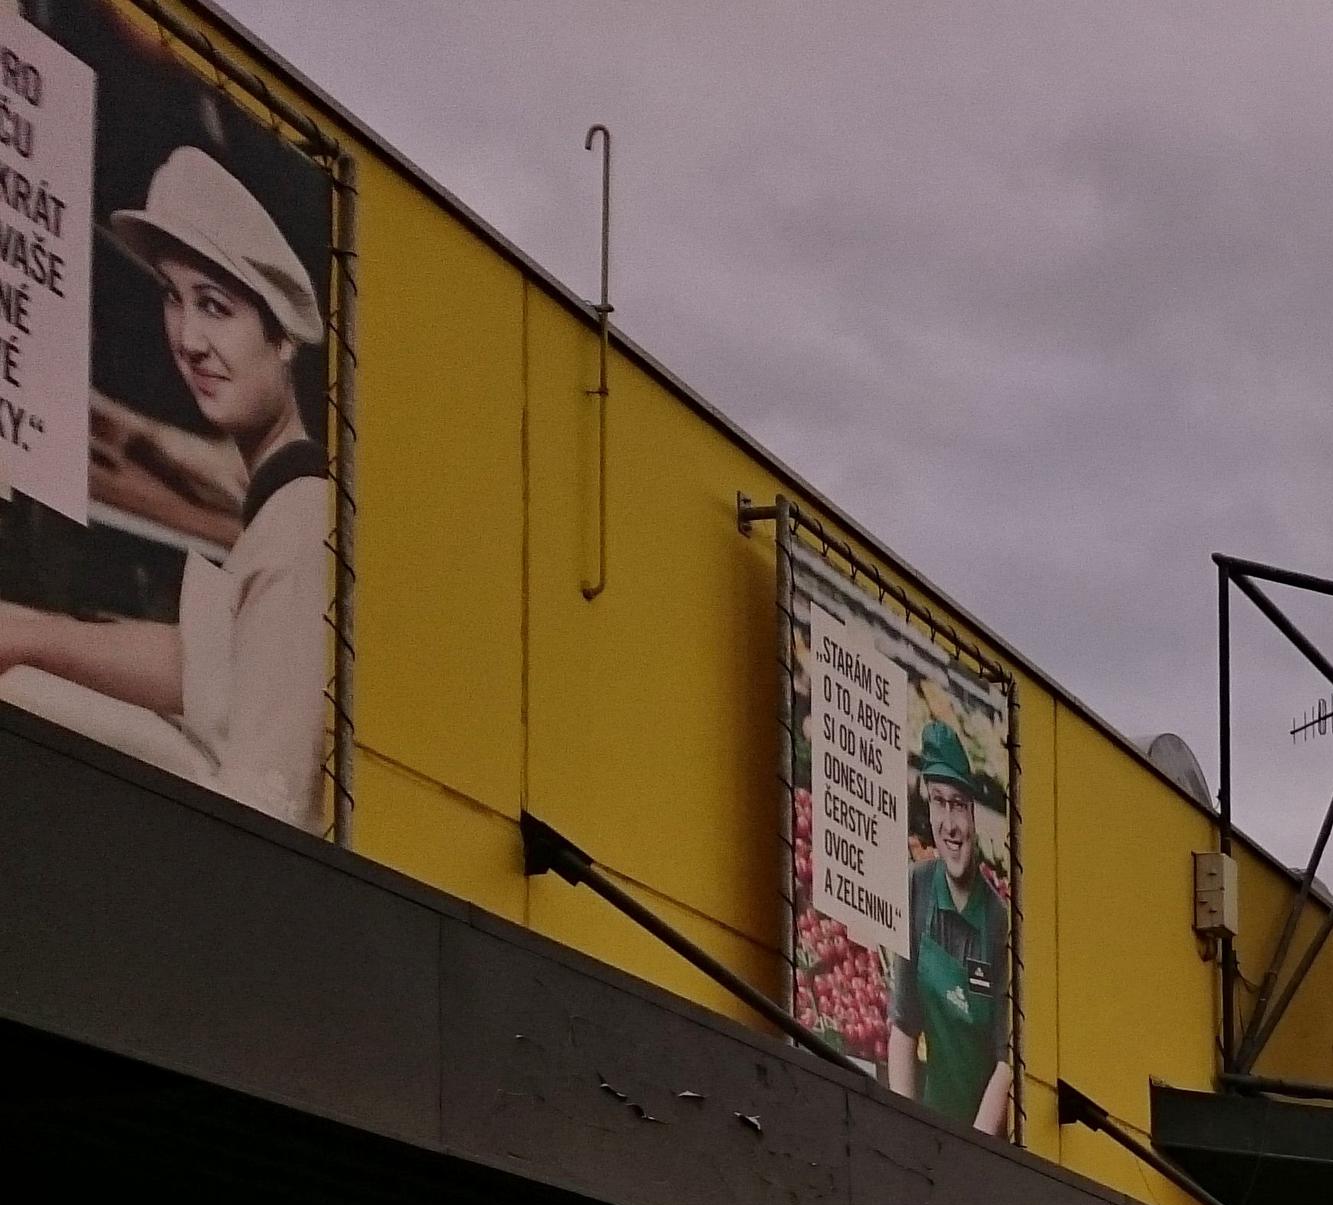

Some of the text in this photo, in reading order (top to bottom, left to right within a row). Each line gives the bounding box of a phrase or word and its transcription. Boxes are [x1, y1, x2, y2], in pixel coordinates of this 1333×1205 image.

[823, 674, 901, 751] O TO, ABYSTE
[875, 673, 890, 707] SE
[823, 713, 883, 775] SI OD NÁS
[824, 752, 897, 822] ODNESLI JEN
[824, 783, 878, 847] ČERSTVÉ
[824, 829, 865, 876] OVOCE
[824, 867, 833, 896] A
